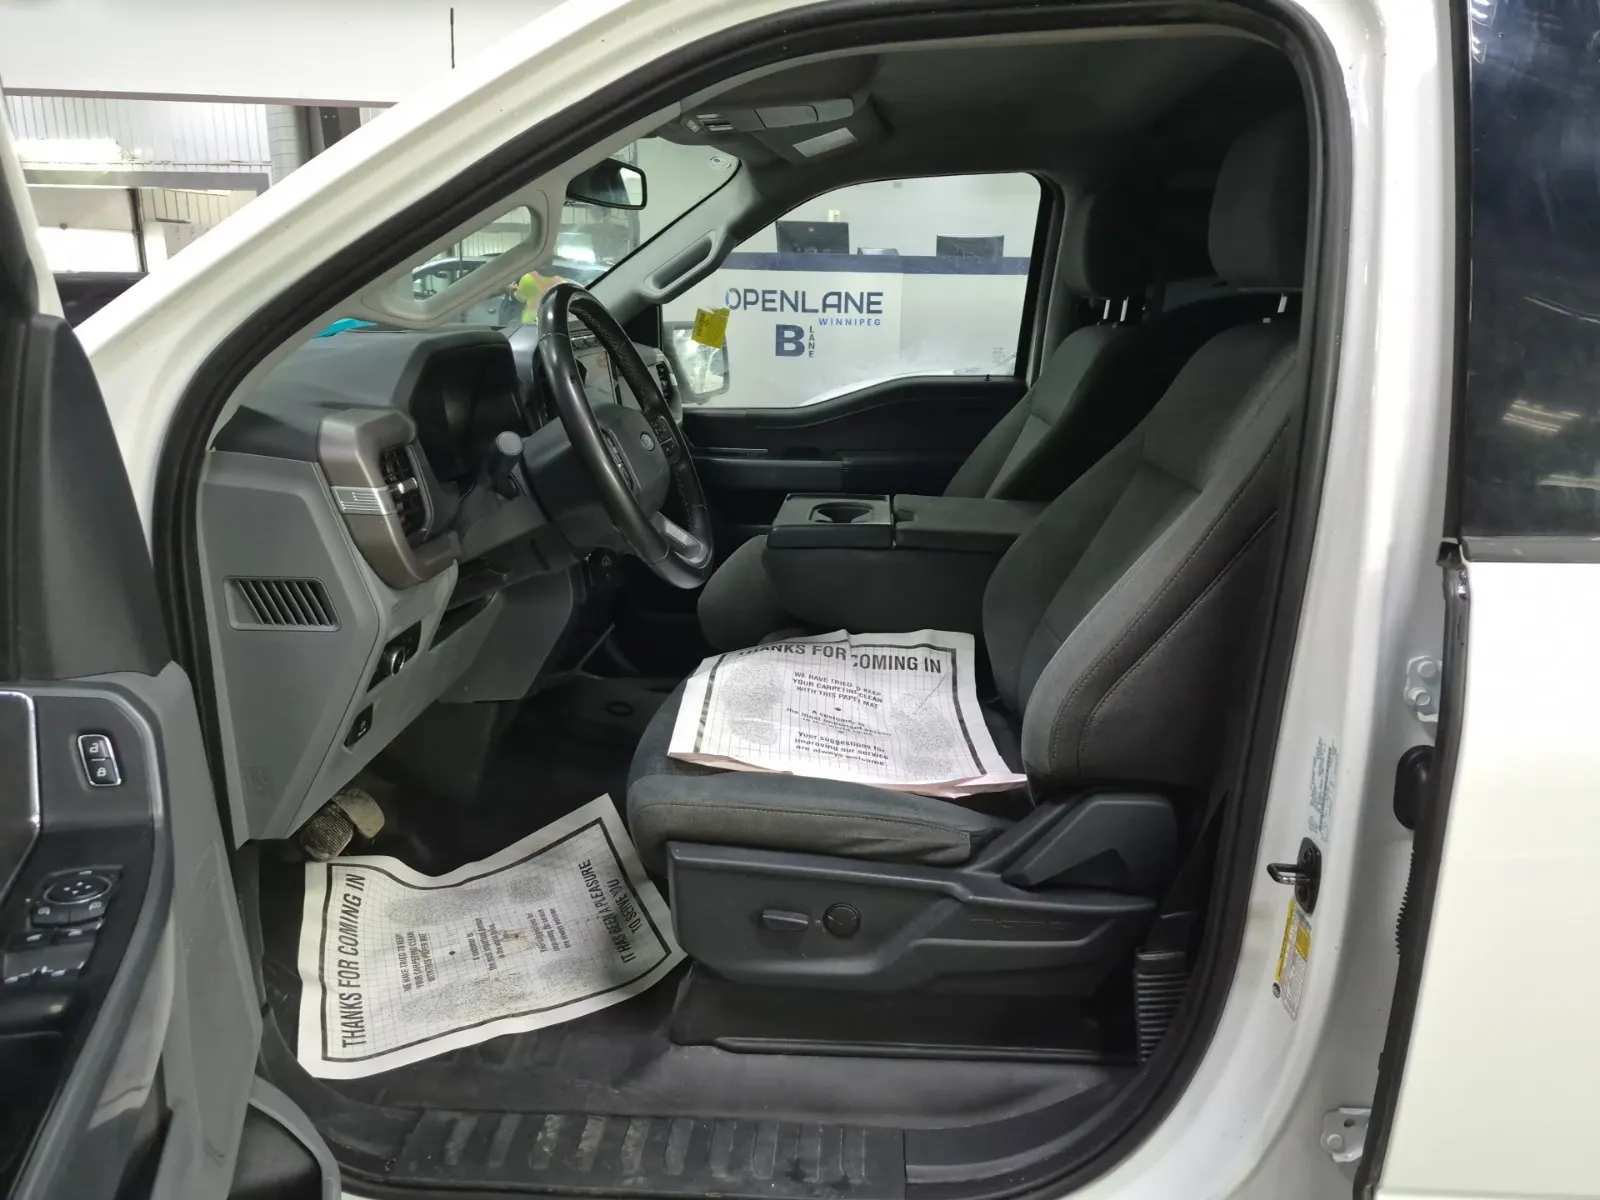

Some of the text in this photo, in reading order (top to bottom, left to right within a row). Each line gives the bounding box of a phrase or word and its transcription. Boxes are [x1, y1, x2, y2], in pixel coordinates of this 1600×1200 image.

[725, 287, 883, 314] OPENLANE
[818, 318, 881, 326] WINNIPEG
[775, 324, 806, 357] B
[808, 325, 816, 358] LANE
[740, 644, 805, 655] ANKS
[812, 645, 846, 660] FOR
[924, 657, 941, 673] IN
[792, 678, 814, 687] YOUR
[858, 692, 883, 703] CLEAN
[796, 685, 816, 694] WITH
[819, 690, 836, 699] THIS
[862, 701, 878, 709] MAT
[808, 674, 829, 683] HAVE
[830, 678, 853, 688] TRIED
[863, 688, 881, 696] KEEP
[795, 738, 889, 760] improving our service
[798, 731, 818, 740] Your
[820, 735, 871, 750] suggestions
[578, 859, 637, 963] IT HAS BEEN A PLEASURE
[615, 893, 637, 922] SERVE
[628, 917, 643, 934] TO
[337, 873, 366, 1048] THANKS FOR COMING IN
